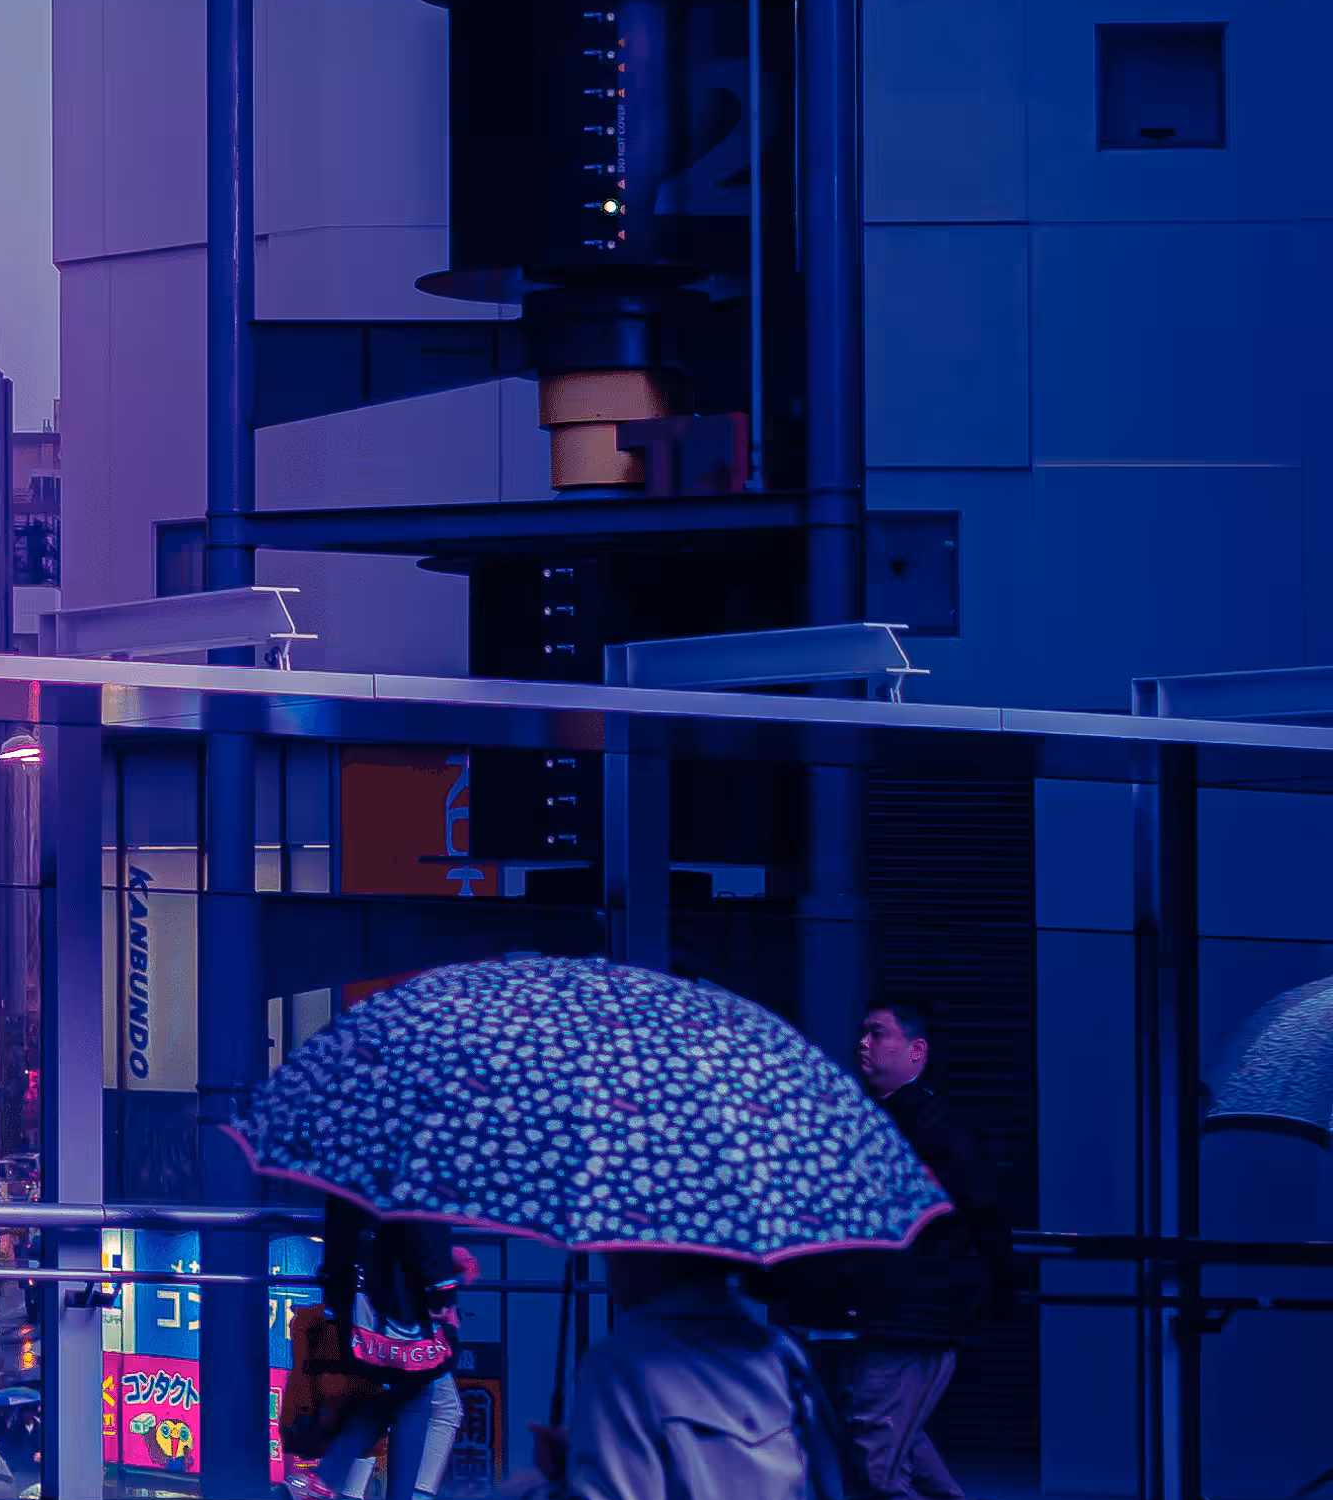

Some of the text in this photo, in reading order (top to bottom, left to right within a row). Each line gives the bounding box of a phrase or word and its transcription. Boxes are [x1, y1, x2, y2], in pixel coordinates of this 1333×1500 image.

[129, 865, 154, 1080] KANBUNDO
[122, 1370, 201, 1410] コンタクト
